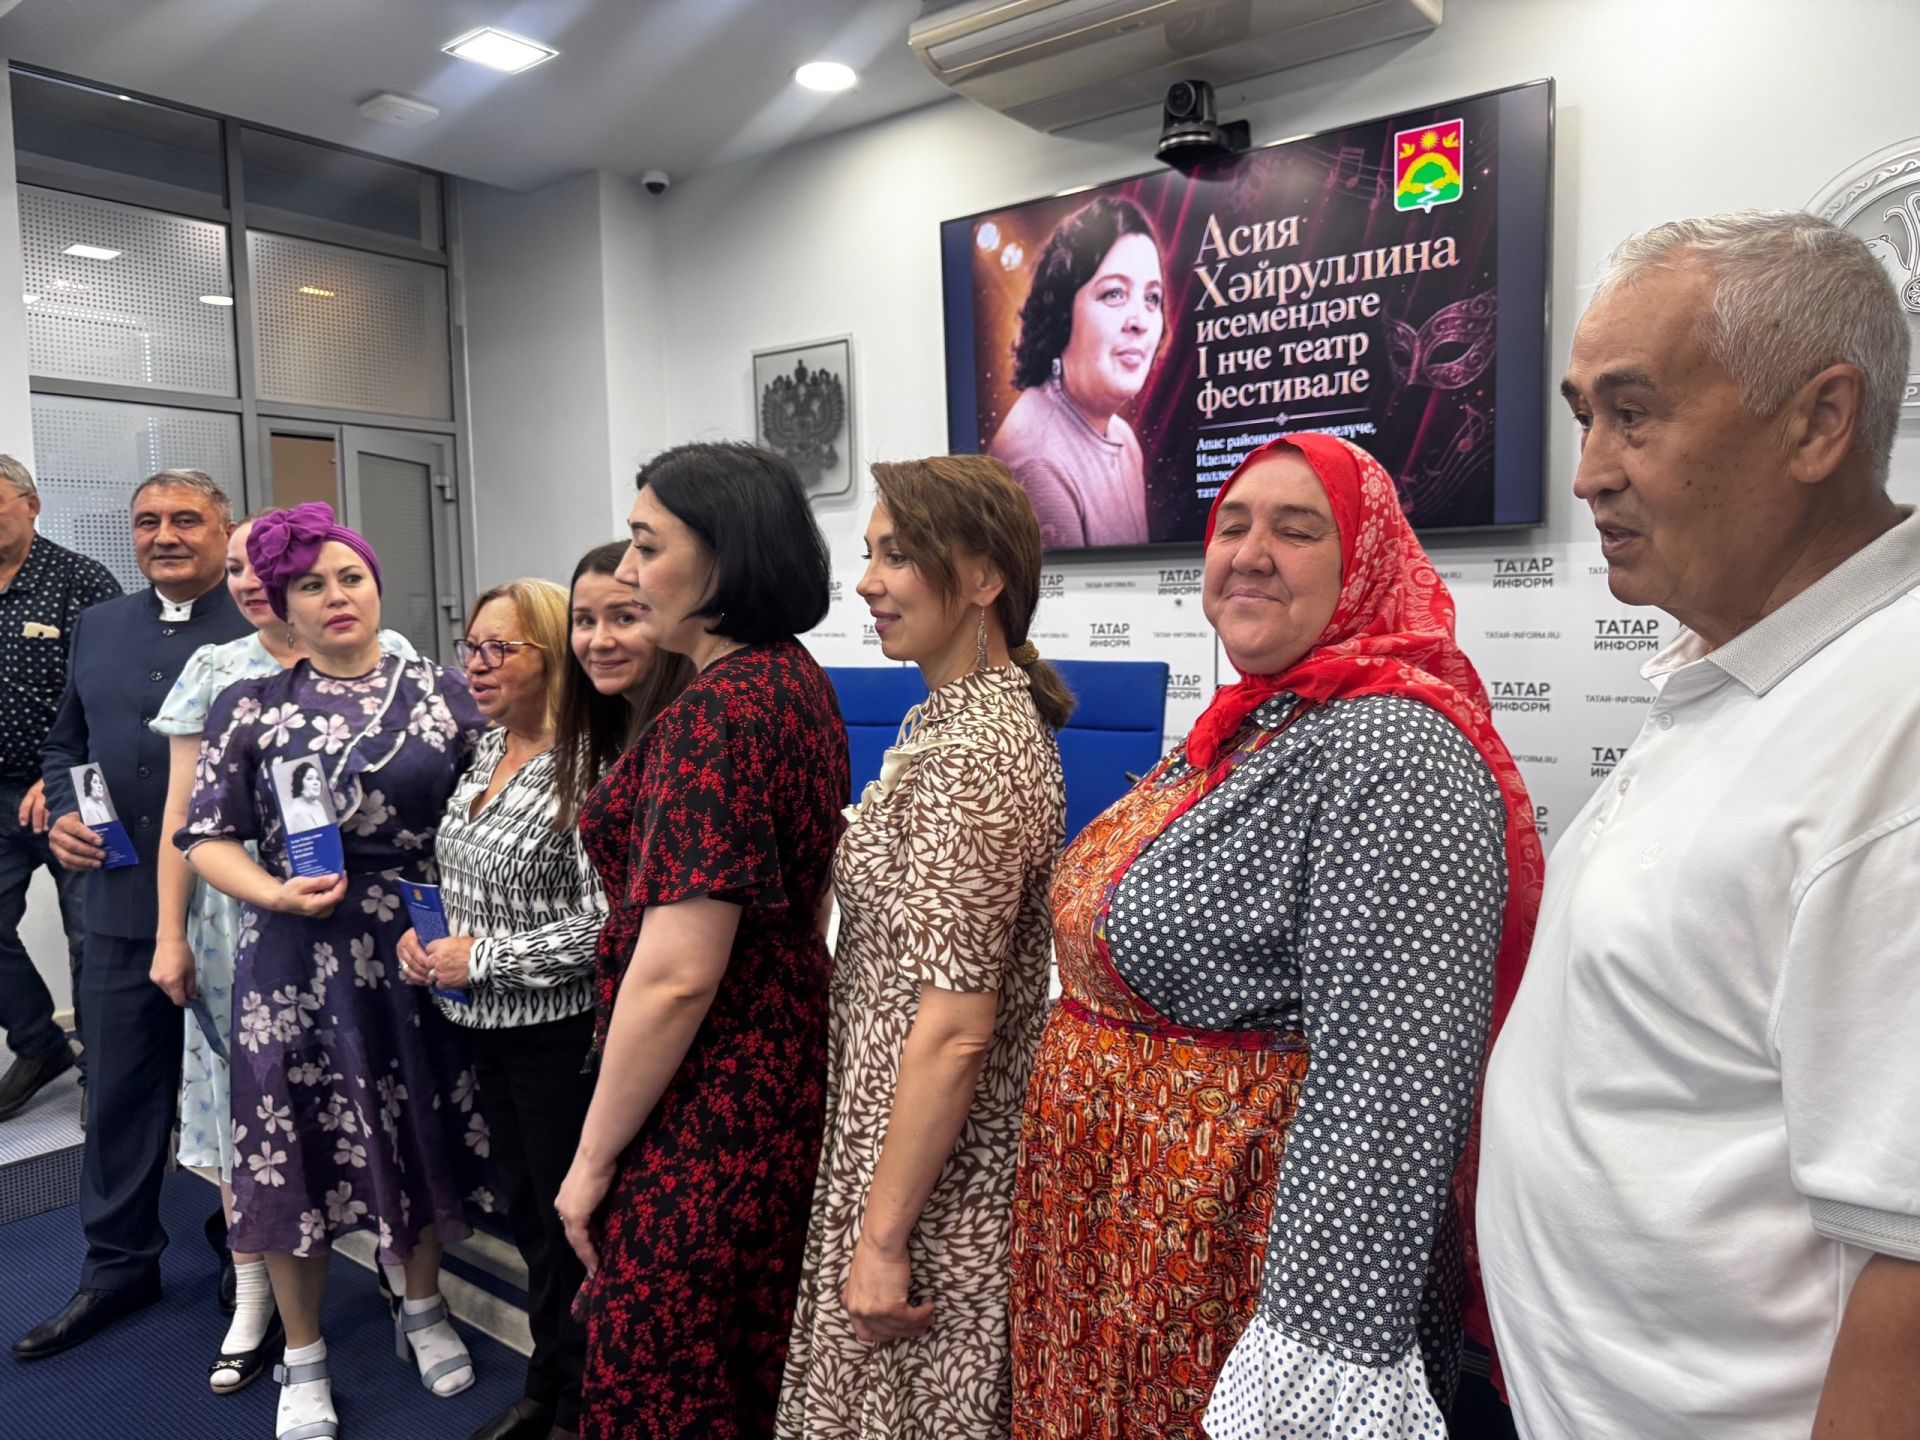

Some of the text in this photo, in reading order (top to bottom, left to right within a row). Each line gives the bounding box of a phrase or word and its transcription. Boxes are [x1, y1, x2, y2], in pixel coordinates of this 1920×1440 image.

[1194, 213, 1300, 265] Асия
[1194, 236, 1460, 311] Хәйруллина
[1196, 292, 1381, 344] исемендәге
[1217, 346, 1272, 376] нче
[1279, 331, 1369, 366] театр
[1196, 368, 1370, 419] фестивале
[1493, 557, 1554, 573] ТАТАР
[1040, 574, 1064, 586] ТАР
[1158, 569, 1202, 582] ТАТАР
[1493, 578, 1554, 589] ИНФОРМ
[1158, 586, 1202, 596] ИНФОРМ
[1089, 623, 1131, 635] ТАТАР
[1594, 619, 1660, 635] ТАТАР
[1484, 631, 1561, 640] TATAR-INFORM.RU
[1089, 639, 1131, 648] ИНФОРМ
[1593, 639, 1660, 651] ИНФОРМ
[1168, 674, 1202, 686] АТАР
[1491, 681, 1551, 697] ТАТАР
[1491, 701, 1551, 713] ИНФОРМ
[1591, 747, 1627, 762] ТАТ
